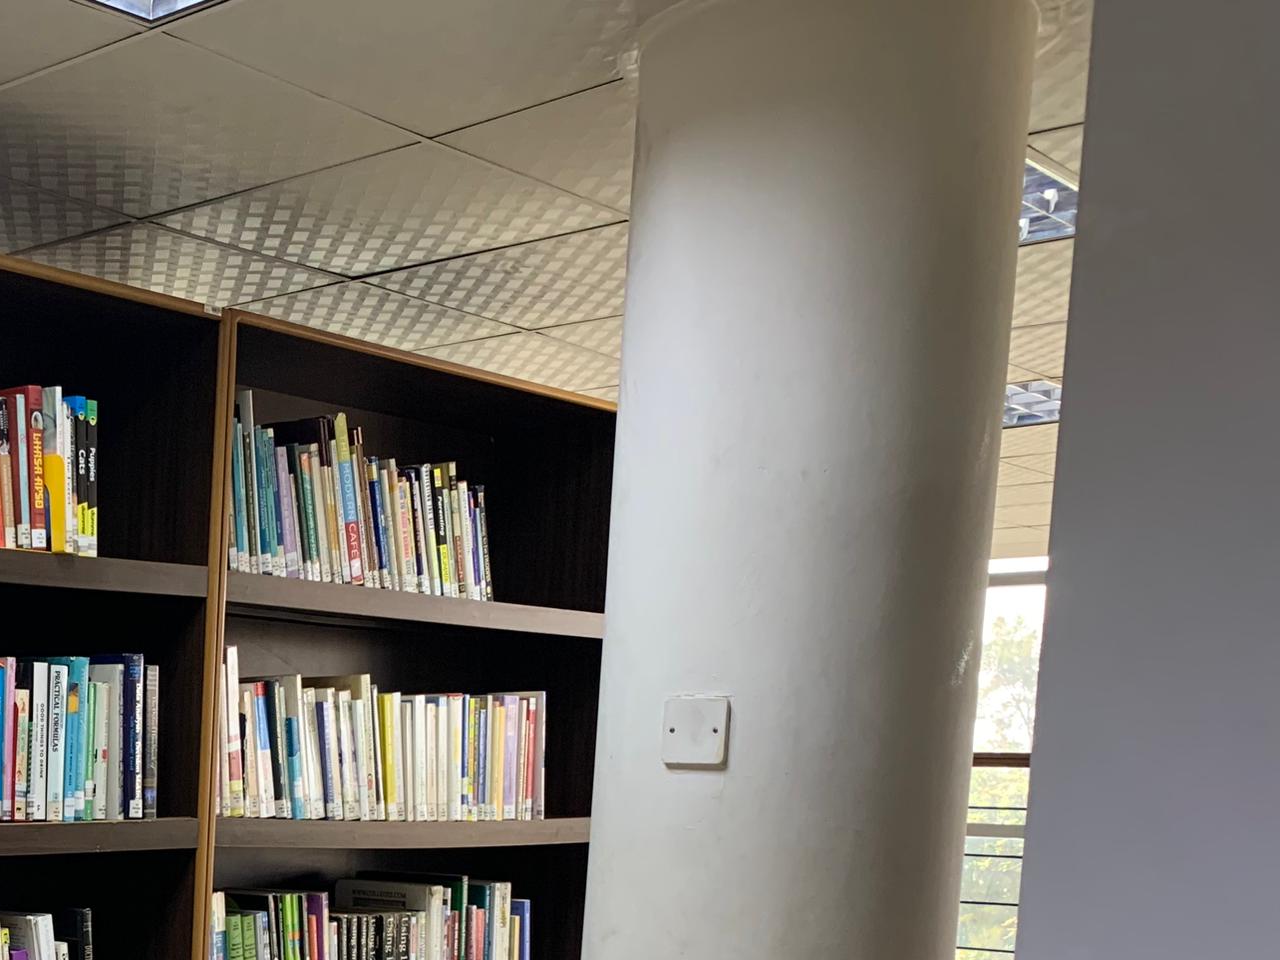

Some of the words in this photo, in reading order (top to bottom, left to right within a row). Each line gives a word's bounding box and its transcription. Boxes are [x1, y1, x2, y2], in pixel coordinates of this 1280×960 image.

[32, 432, 43, 475] LHASA
[78, 449, 87, 475] Cats
[88, 447, 97, 482] Puppies
[342, 462, 355, 520] MODERN
[437, 495, 446, 536] Parenting
[52, 670, 61, 710] PRACTICAL
[52, 712, 60, 753] FORMULAS
[385, 916, 394, 953] Using
[399, 916, 409, 952] Using
